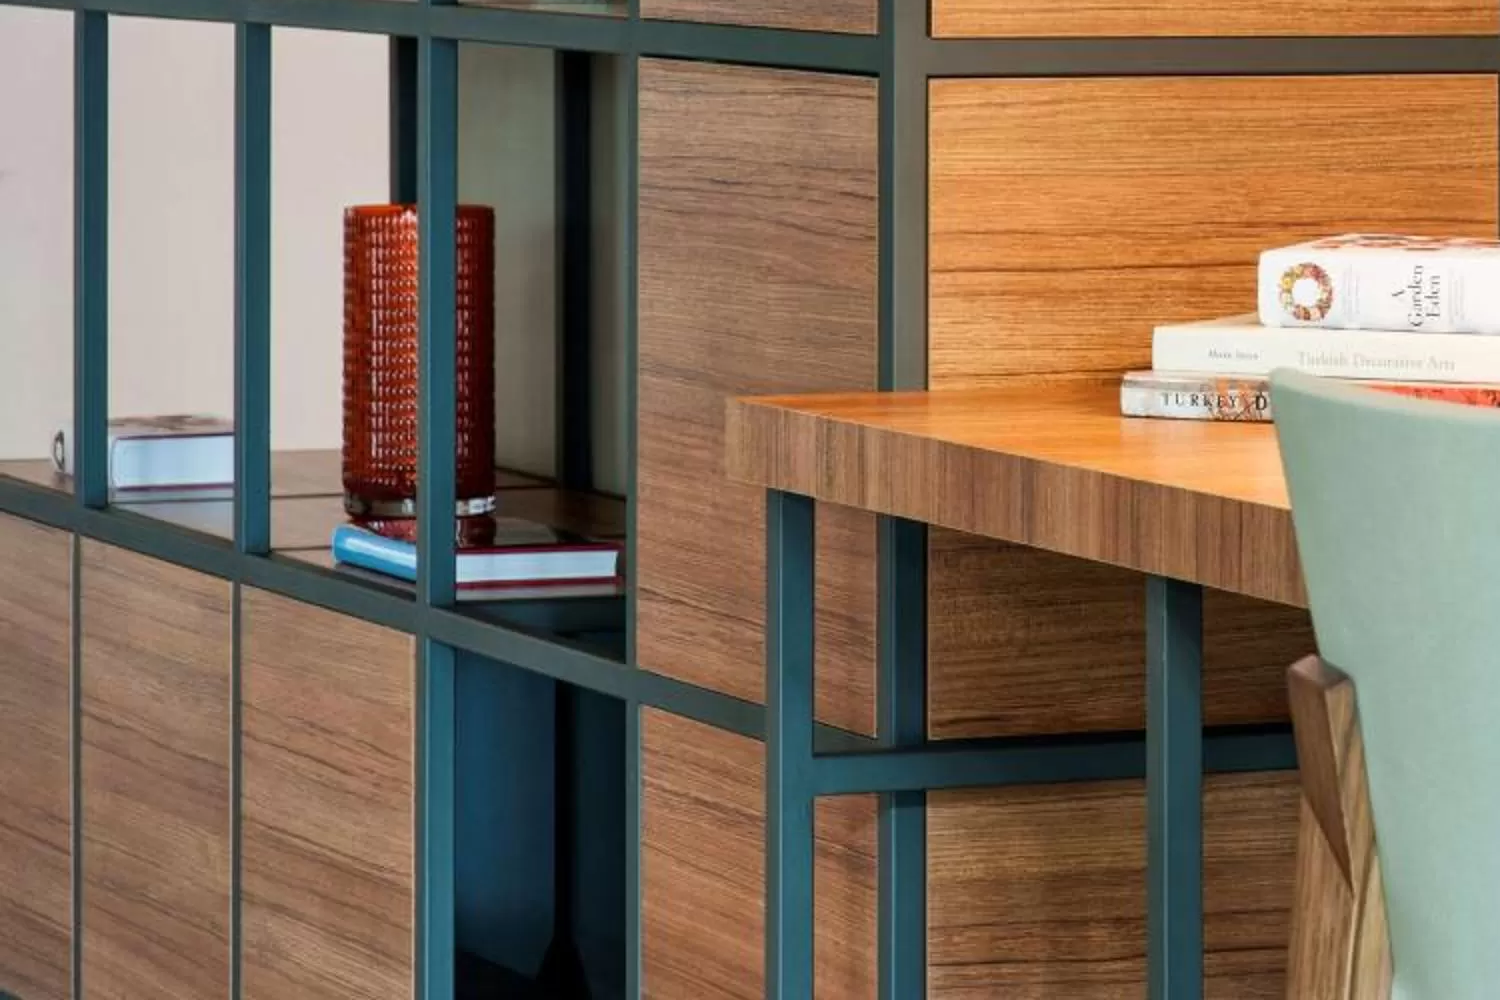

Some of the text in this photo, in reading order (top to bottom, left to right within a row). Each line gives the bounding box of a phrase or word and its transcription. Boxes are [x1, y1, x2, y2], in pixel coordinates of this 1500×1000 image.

[1407, 265, 1424, 327] Garden
[1424, 275, 1441, 320] Eden
[1298, 350, 1347, 366] Turkish
[1427, 355, 1457, 371] Arts
[1160, 391, 1238, 409] TURKEY
